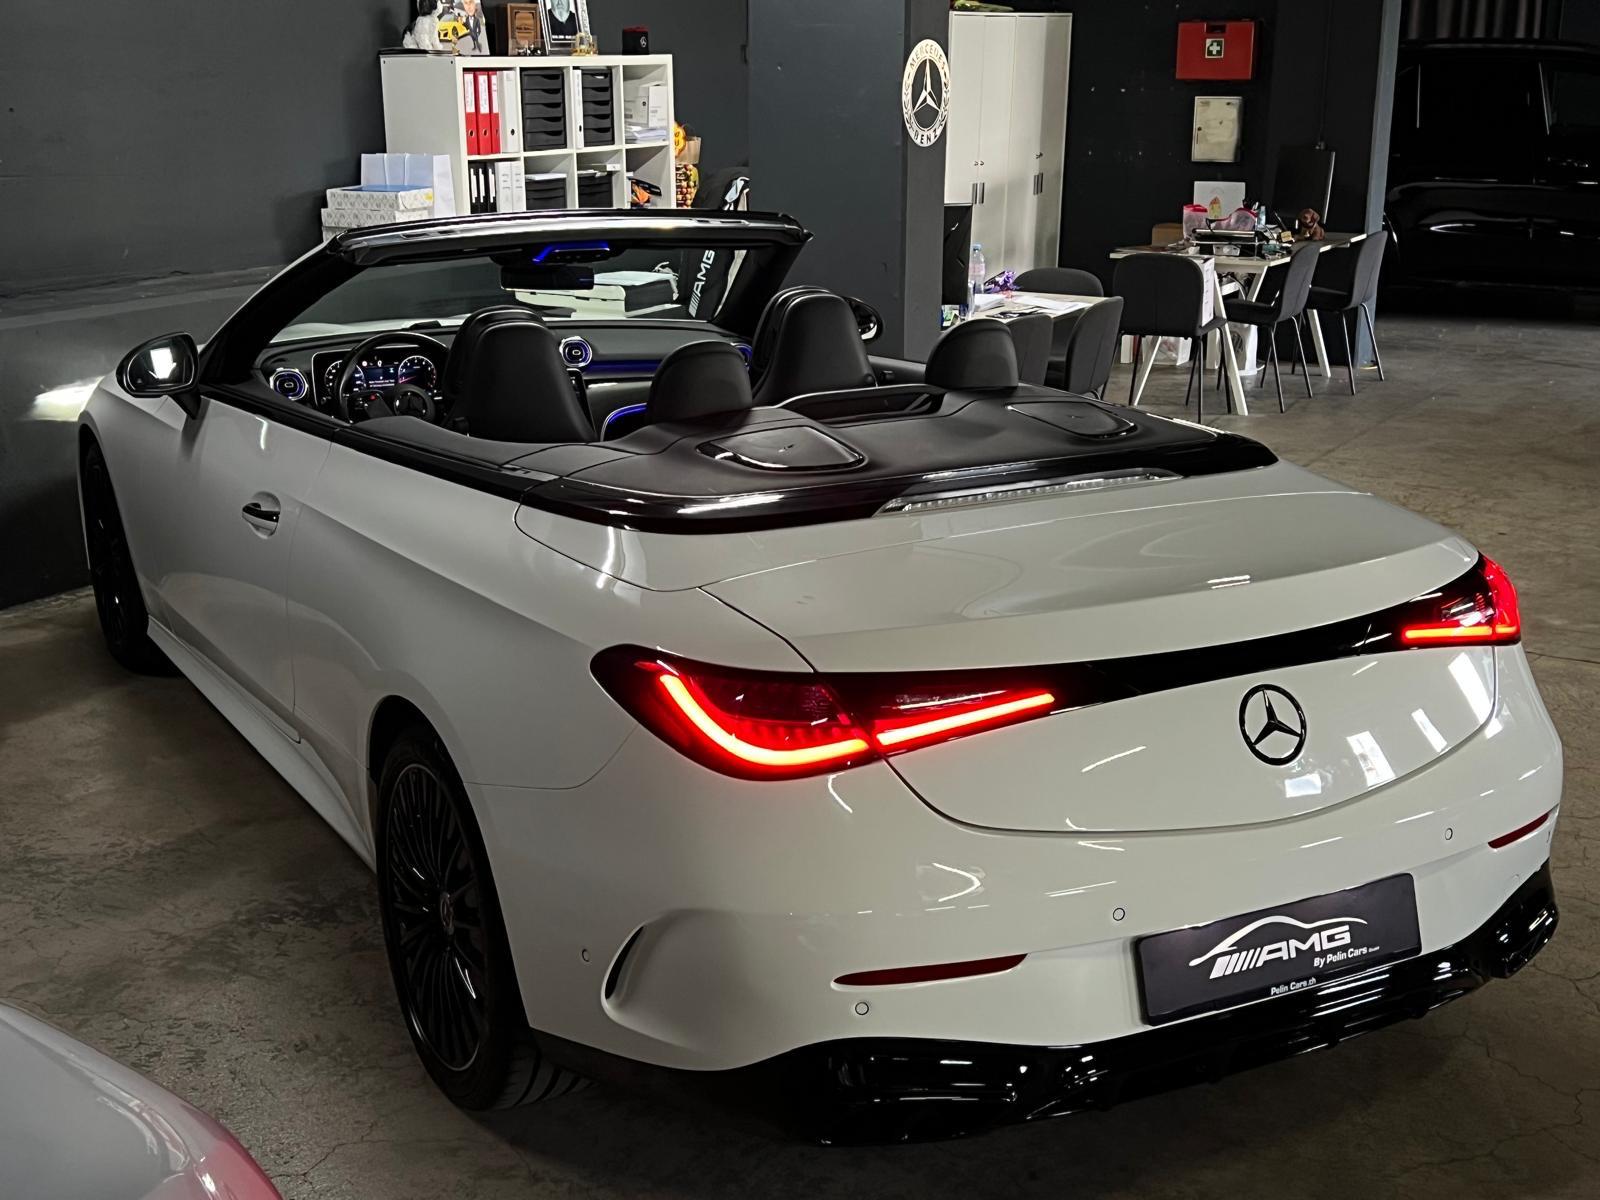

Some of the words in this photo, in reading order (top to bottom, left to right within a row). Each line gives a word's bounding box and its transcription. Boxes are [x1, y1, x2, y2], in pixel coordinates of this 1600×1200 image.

[1255, 925, 1351, 968] AMG
[1313, 957, 1325, 968] By
[1347, 946, 1368, 959] Cars
[1270, 984, 1289, 996] Pelin
